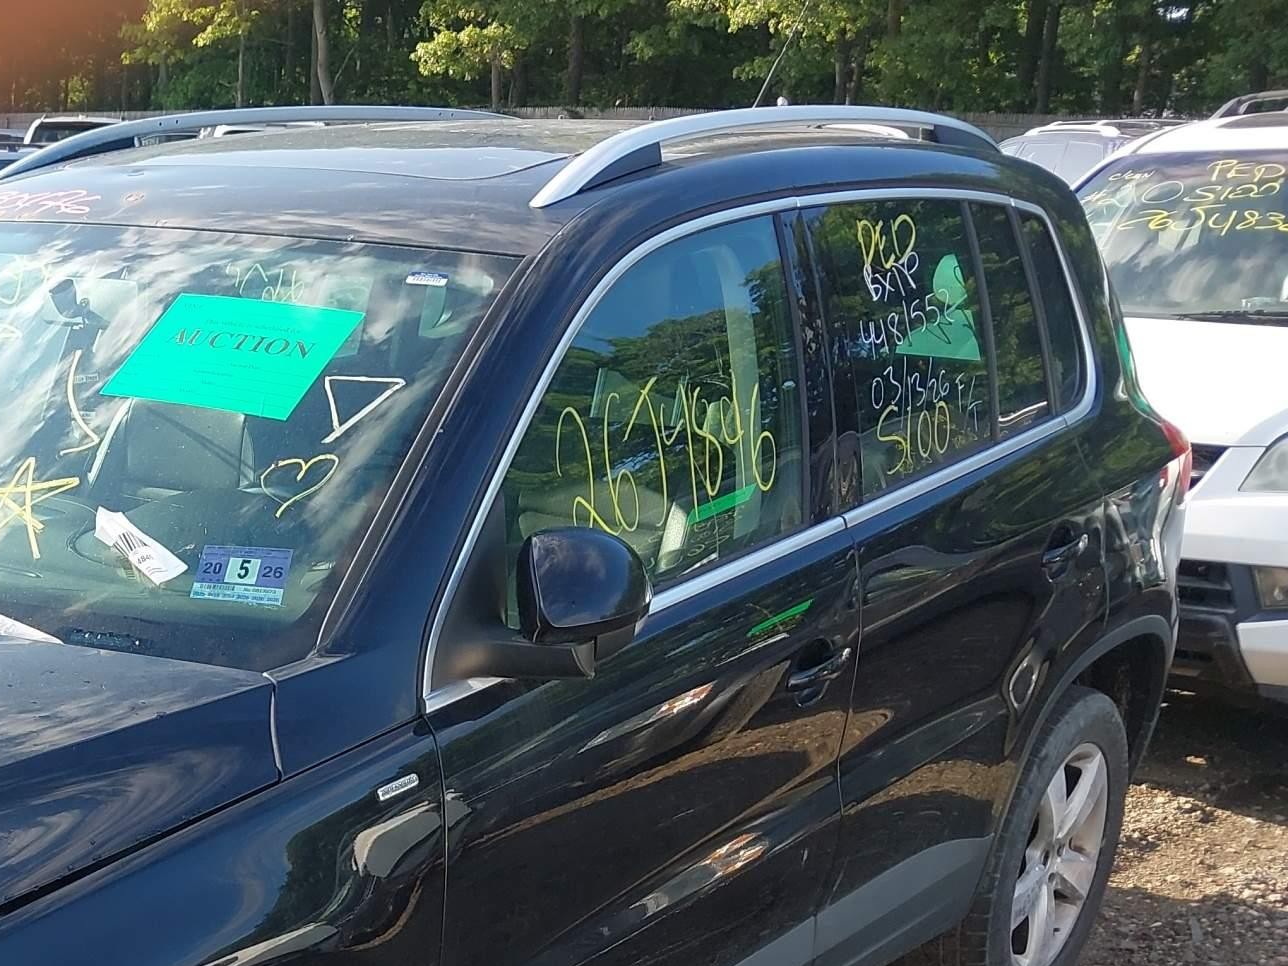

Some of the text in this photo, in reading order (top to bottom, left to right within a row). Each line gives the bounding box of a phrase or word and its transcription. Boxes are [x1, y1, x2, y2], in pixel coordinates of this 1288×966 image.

[1208, 159, 1286, 182] PED
[857, 214, 916, 270] PED
[166, 326, 318, 361] AUCTION
[871, 355, 950, 428] 03/13/26
[877, 400, 950, 475] S100
[203, 559, 285, 580] 20 5 26
